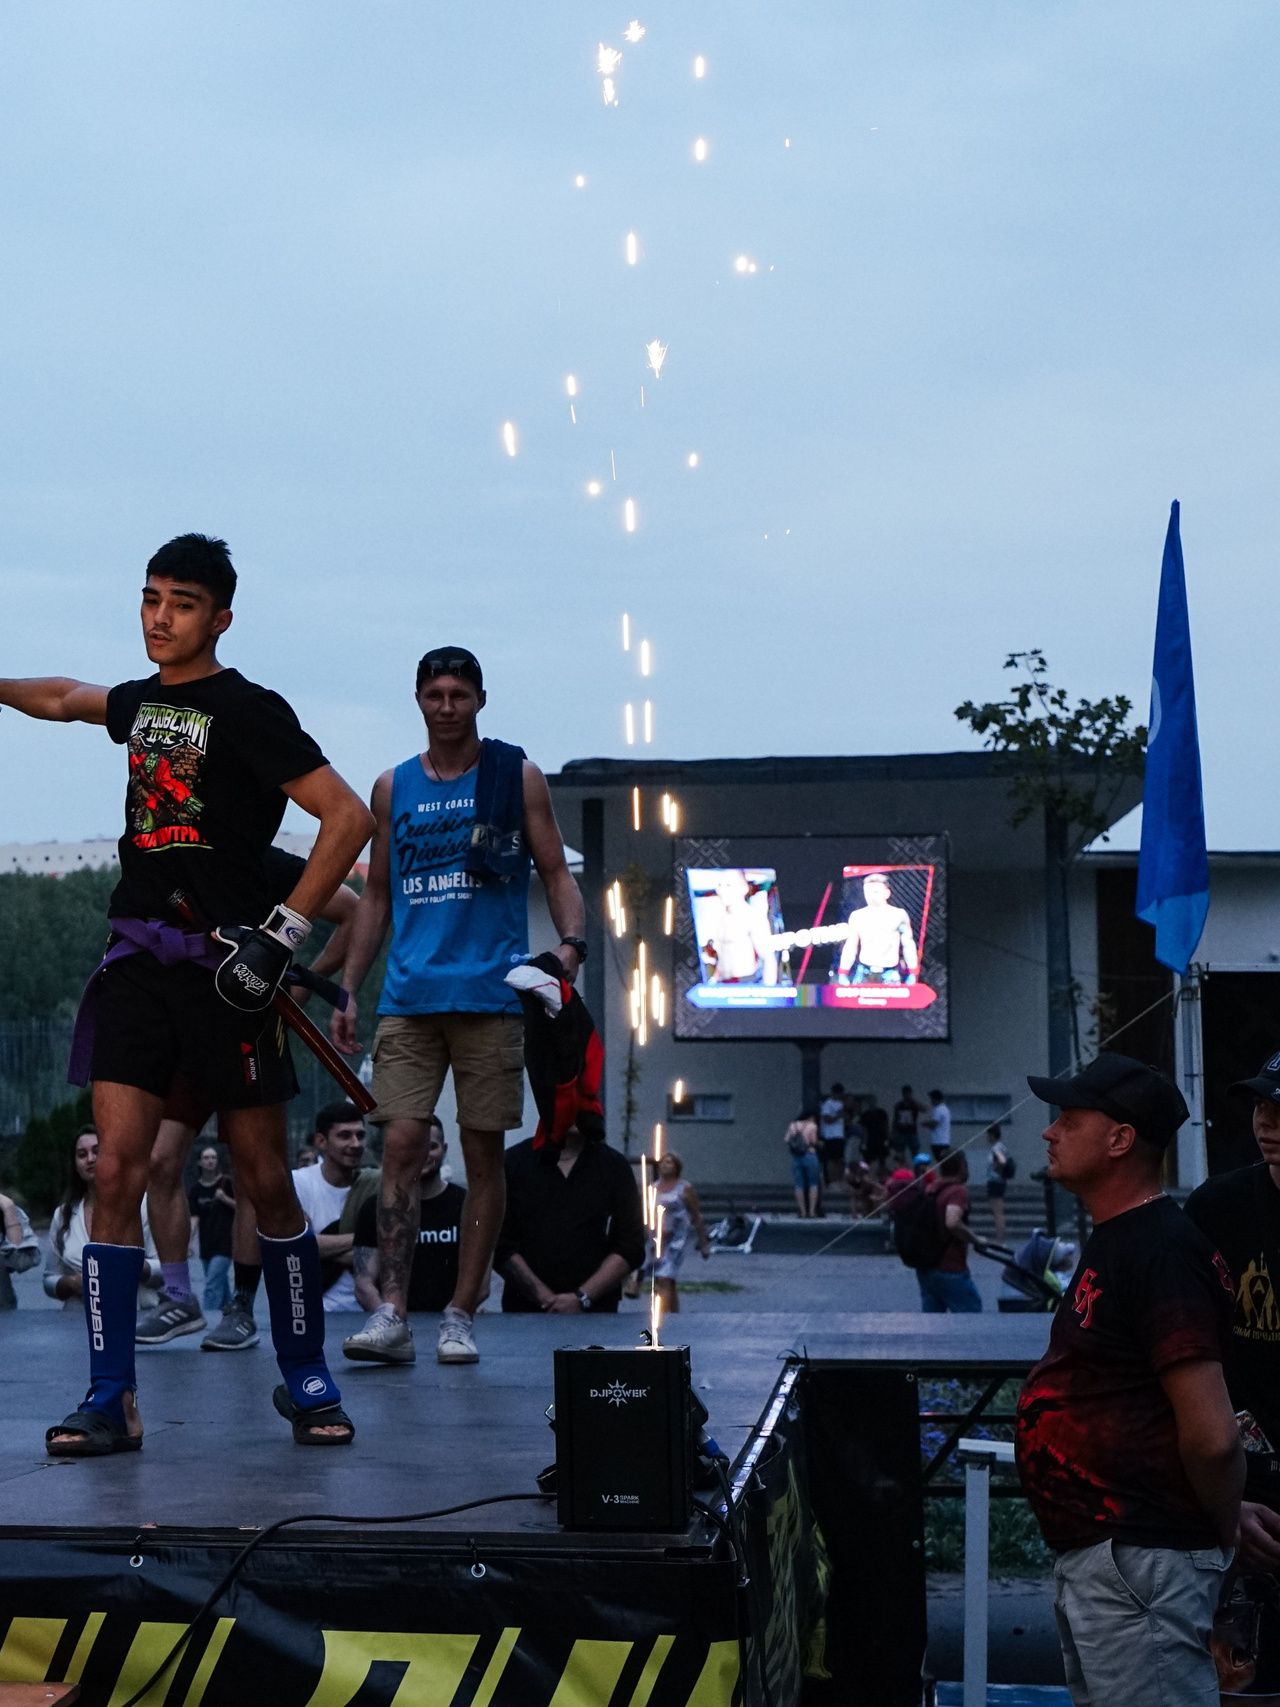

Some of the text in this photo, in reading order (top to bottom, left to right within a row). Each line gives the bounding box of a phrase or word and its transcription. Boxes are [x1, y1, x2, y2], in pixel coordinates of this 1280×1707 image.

[418, 799, 475, 812] WEST COAST
[403, 877, 423, 895] LOS
[248, 1057, 257, 1081] AKRON
[87, 1254, 105, 1351] BOYBO
[286, 1253, 307, 1336] BOYBO
[601, 1494, 620, 1504] V-3
